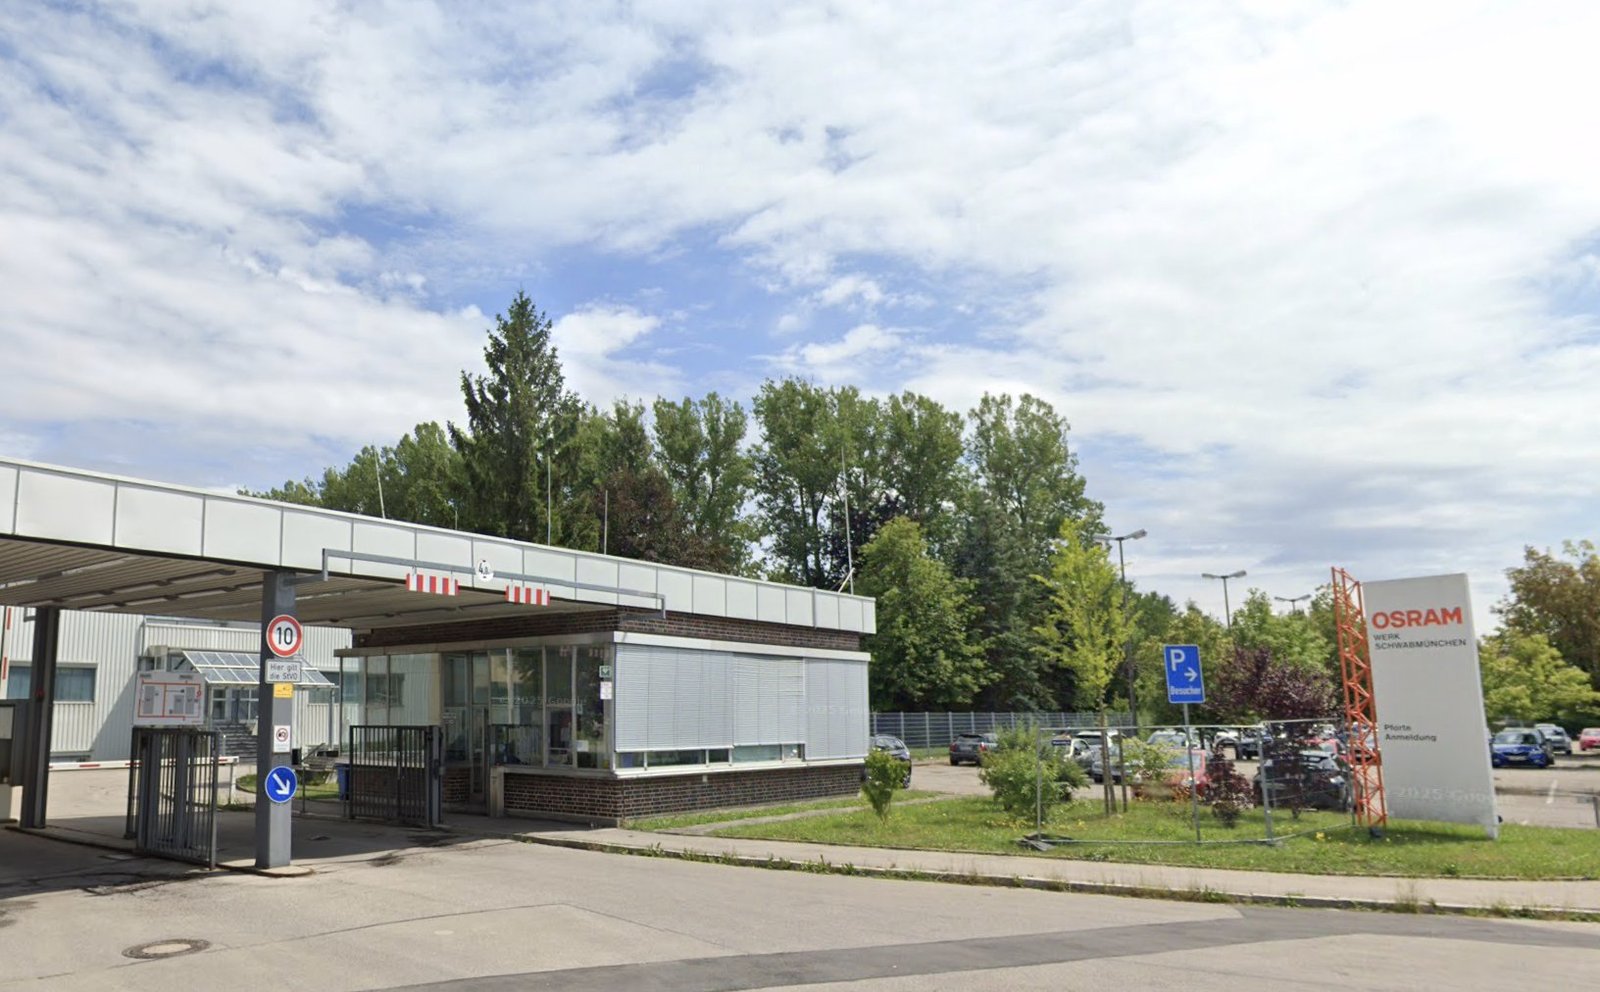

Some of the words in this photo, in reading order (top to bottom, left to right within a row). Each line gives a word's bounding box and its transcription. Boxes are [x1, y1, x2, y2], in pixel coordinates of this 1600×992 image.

[1372, 607, 1463, 629] OSRAM
[276, 626, 293, 645] 10
[1375, 639, 1467, 650] SCHWABMÜNCHEN
[1170, 649, 1185, 671] P
[270, 663, 284, 671] Hier
[287, 663, 298, 672] gilt
[269, 672, 280, 680] die
[1386, 733, 1437, 742] Anmeldung
